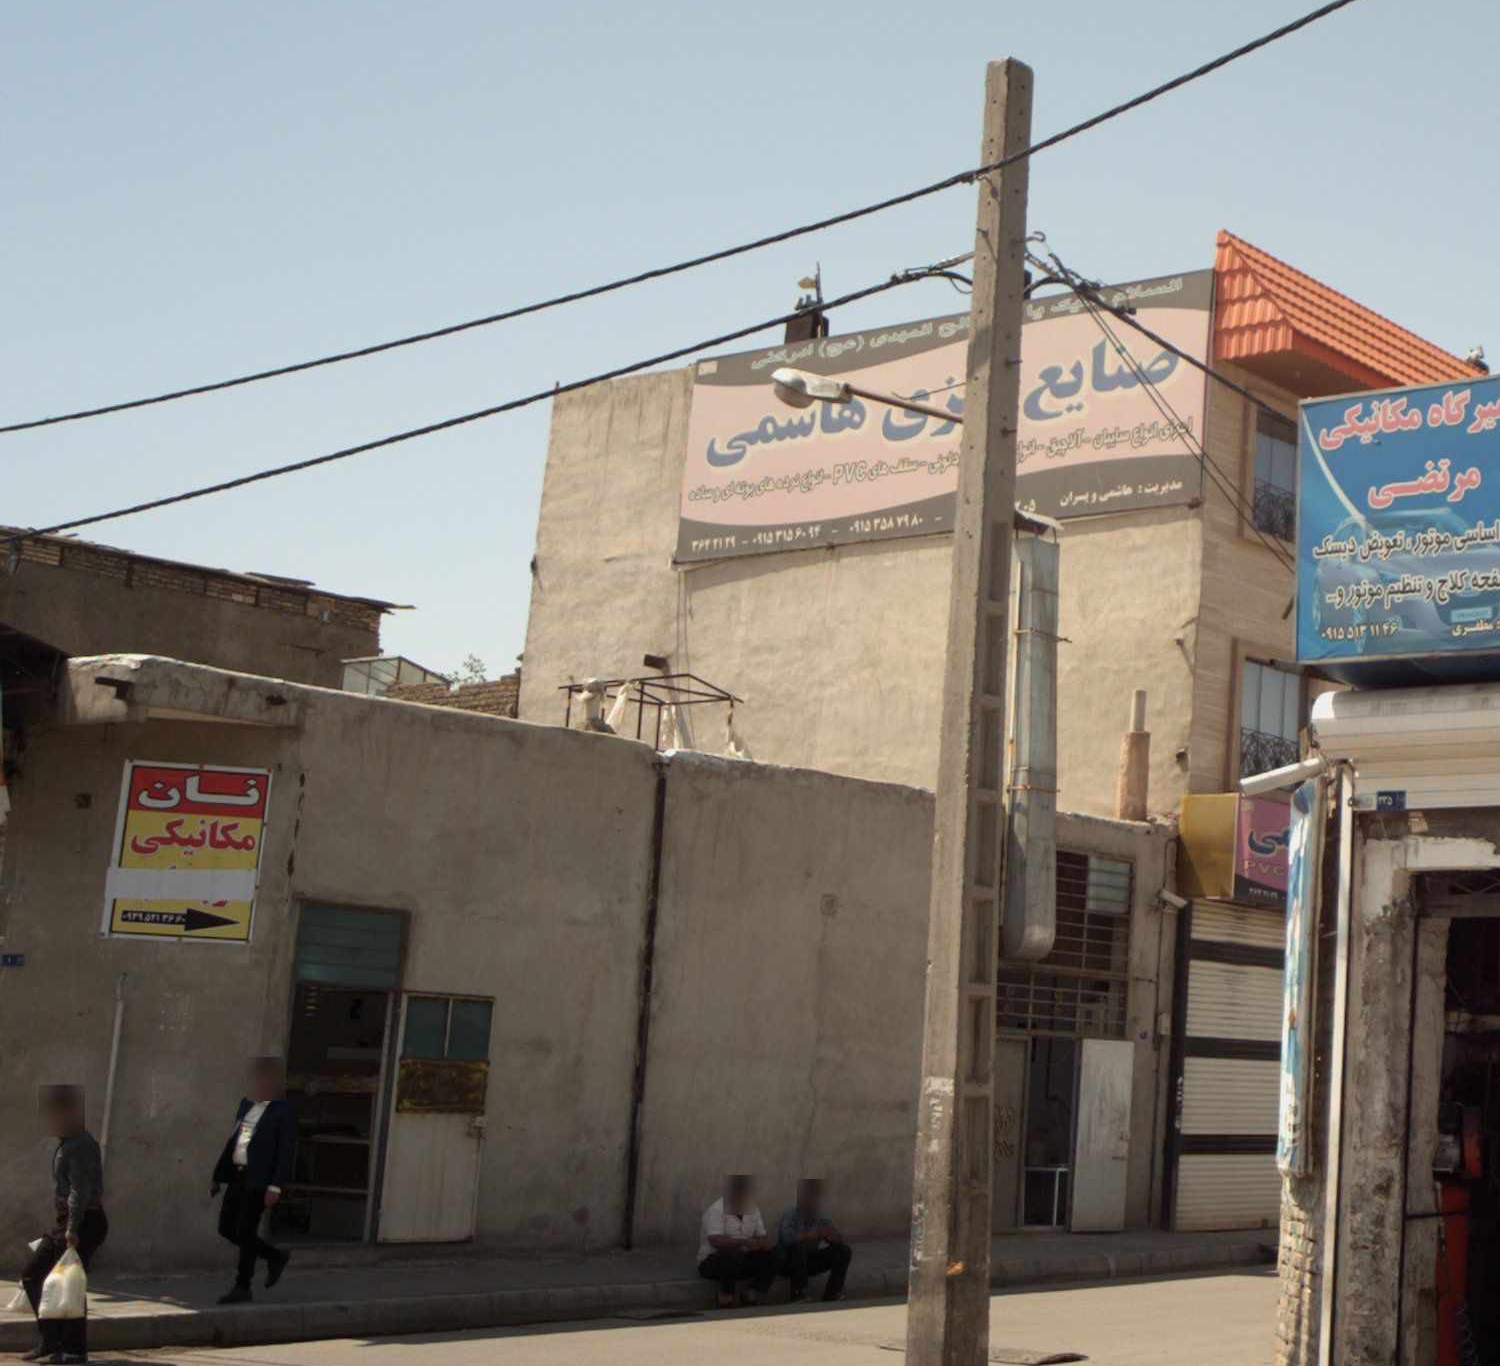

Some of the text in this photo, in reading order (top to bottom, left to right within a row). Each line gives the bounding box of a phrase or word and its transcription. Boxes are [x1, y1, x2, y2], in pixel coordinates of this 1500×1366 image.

[1023, 335, 1180, 421] صنایع
[882, 375, 965, 442] زی
[1318, 397, 1423, 450] مکانیکی
[1016, 437, 1037, 463] انوا
[832, 460, 867, 485] PVC
[1367, 458, 1482, 510] مرتضی
[1312, 535, 1357, 559] دیسک
[1359, 529, 1406, 562] تعویض
[1347, 582, 1383, 608] موتور
[1384, 575, 1423, 608] تنظیم
[1424, 579, 1434, 601] و
[1436, 570, 1468, 604] کلاج
[138, 774, 260, 809] نان
[130, 819, 256, 856] مکانیکی
[1243, 858, 1286, 877] PVC
